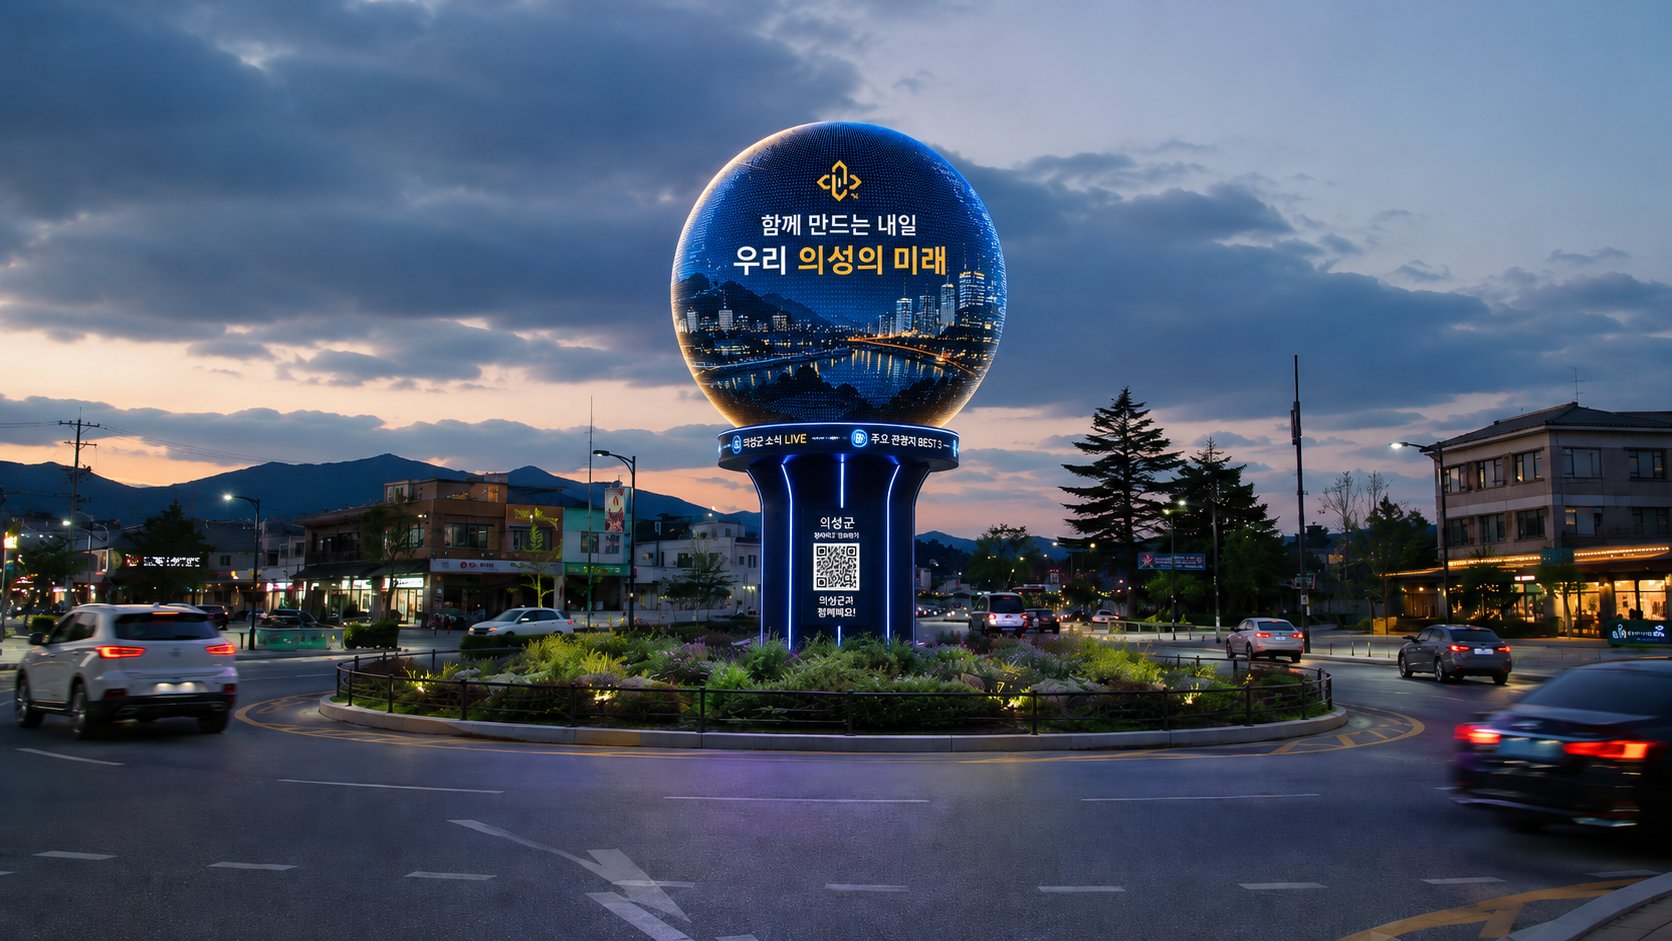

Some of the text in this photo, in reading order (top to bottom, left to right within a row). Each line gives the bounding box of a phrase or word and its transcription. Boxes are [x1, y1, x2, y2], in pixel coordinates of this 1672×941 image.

[761, 214, 916, 236] 함께 만드는 내일
[733, 245, 946, 275] 우리 의성의 미래
[765, 434, 782, 445] 소식
[784, 433, 807, 444] LIVE
[871, 433, 890, 444] 주요
[891, 434, 916, 447] 관광지
[820, 516, 855, 530] 의성군
